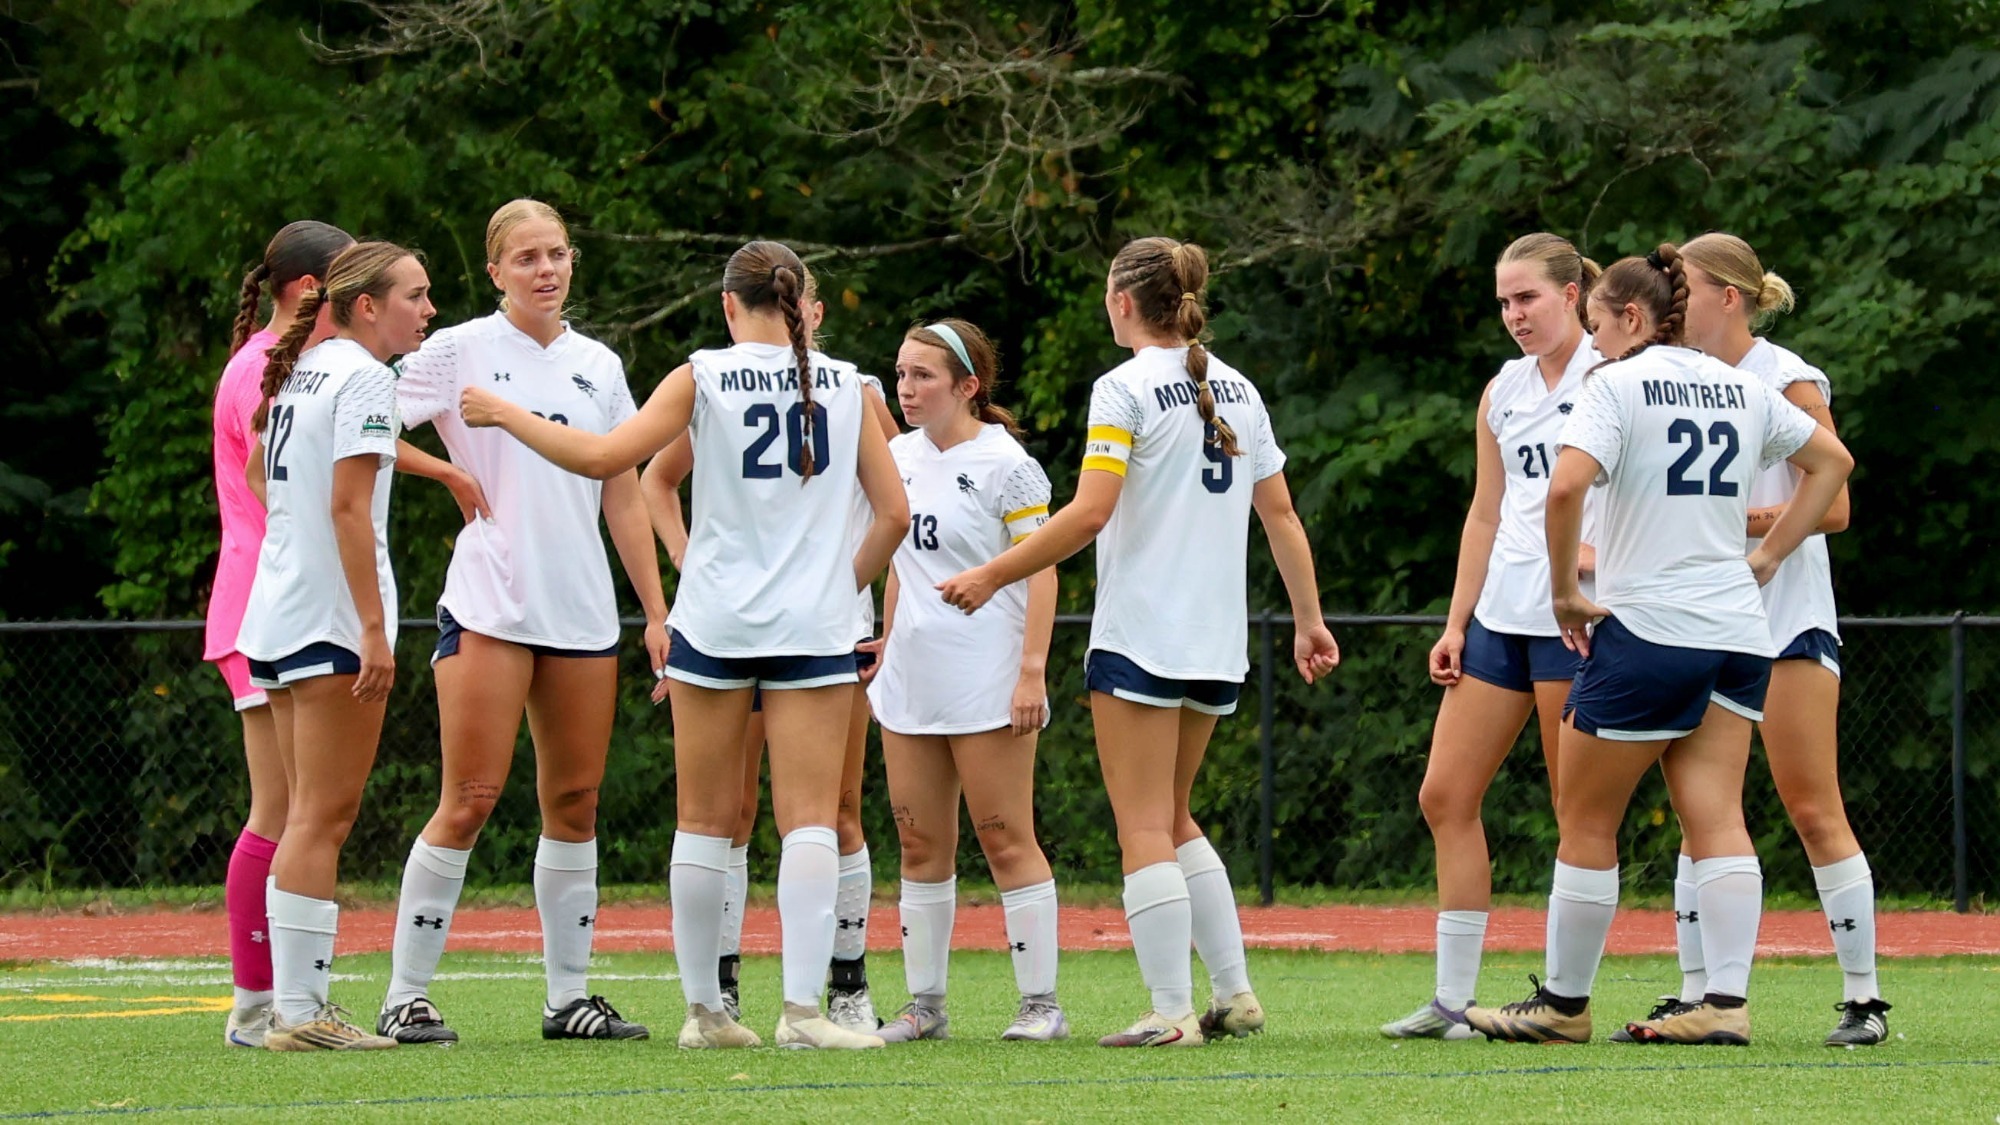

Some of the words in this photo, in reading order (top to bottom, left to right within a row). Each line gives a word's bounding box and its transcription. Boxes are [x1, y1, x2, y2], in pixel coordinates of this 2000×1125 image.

[281, 369, 330, 394] NTREAT
[719, 367, 841, 392] MONTRAT
[1154, 379, 1251, 412] MONREAT
[1642, 379, 1746, 409] MONTREAT
[366, 414, 389, 425] AAC
[267, 404, 294, 482] 12
[742, 400, 830, 479] 20
[1201, 415, 1233, 494] 9
[1666, 417, 1740, 497] 22
[1517, 442, 1550, 479] 21
[911, 513, 939, 551] 13
